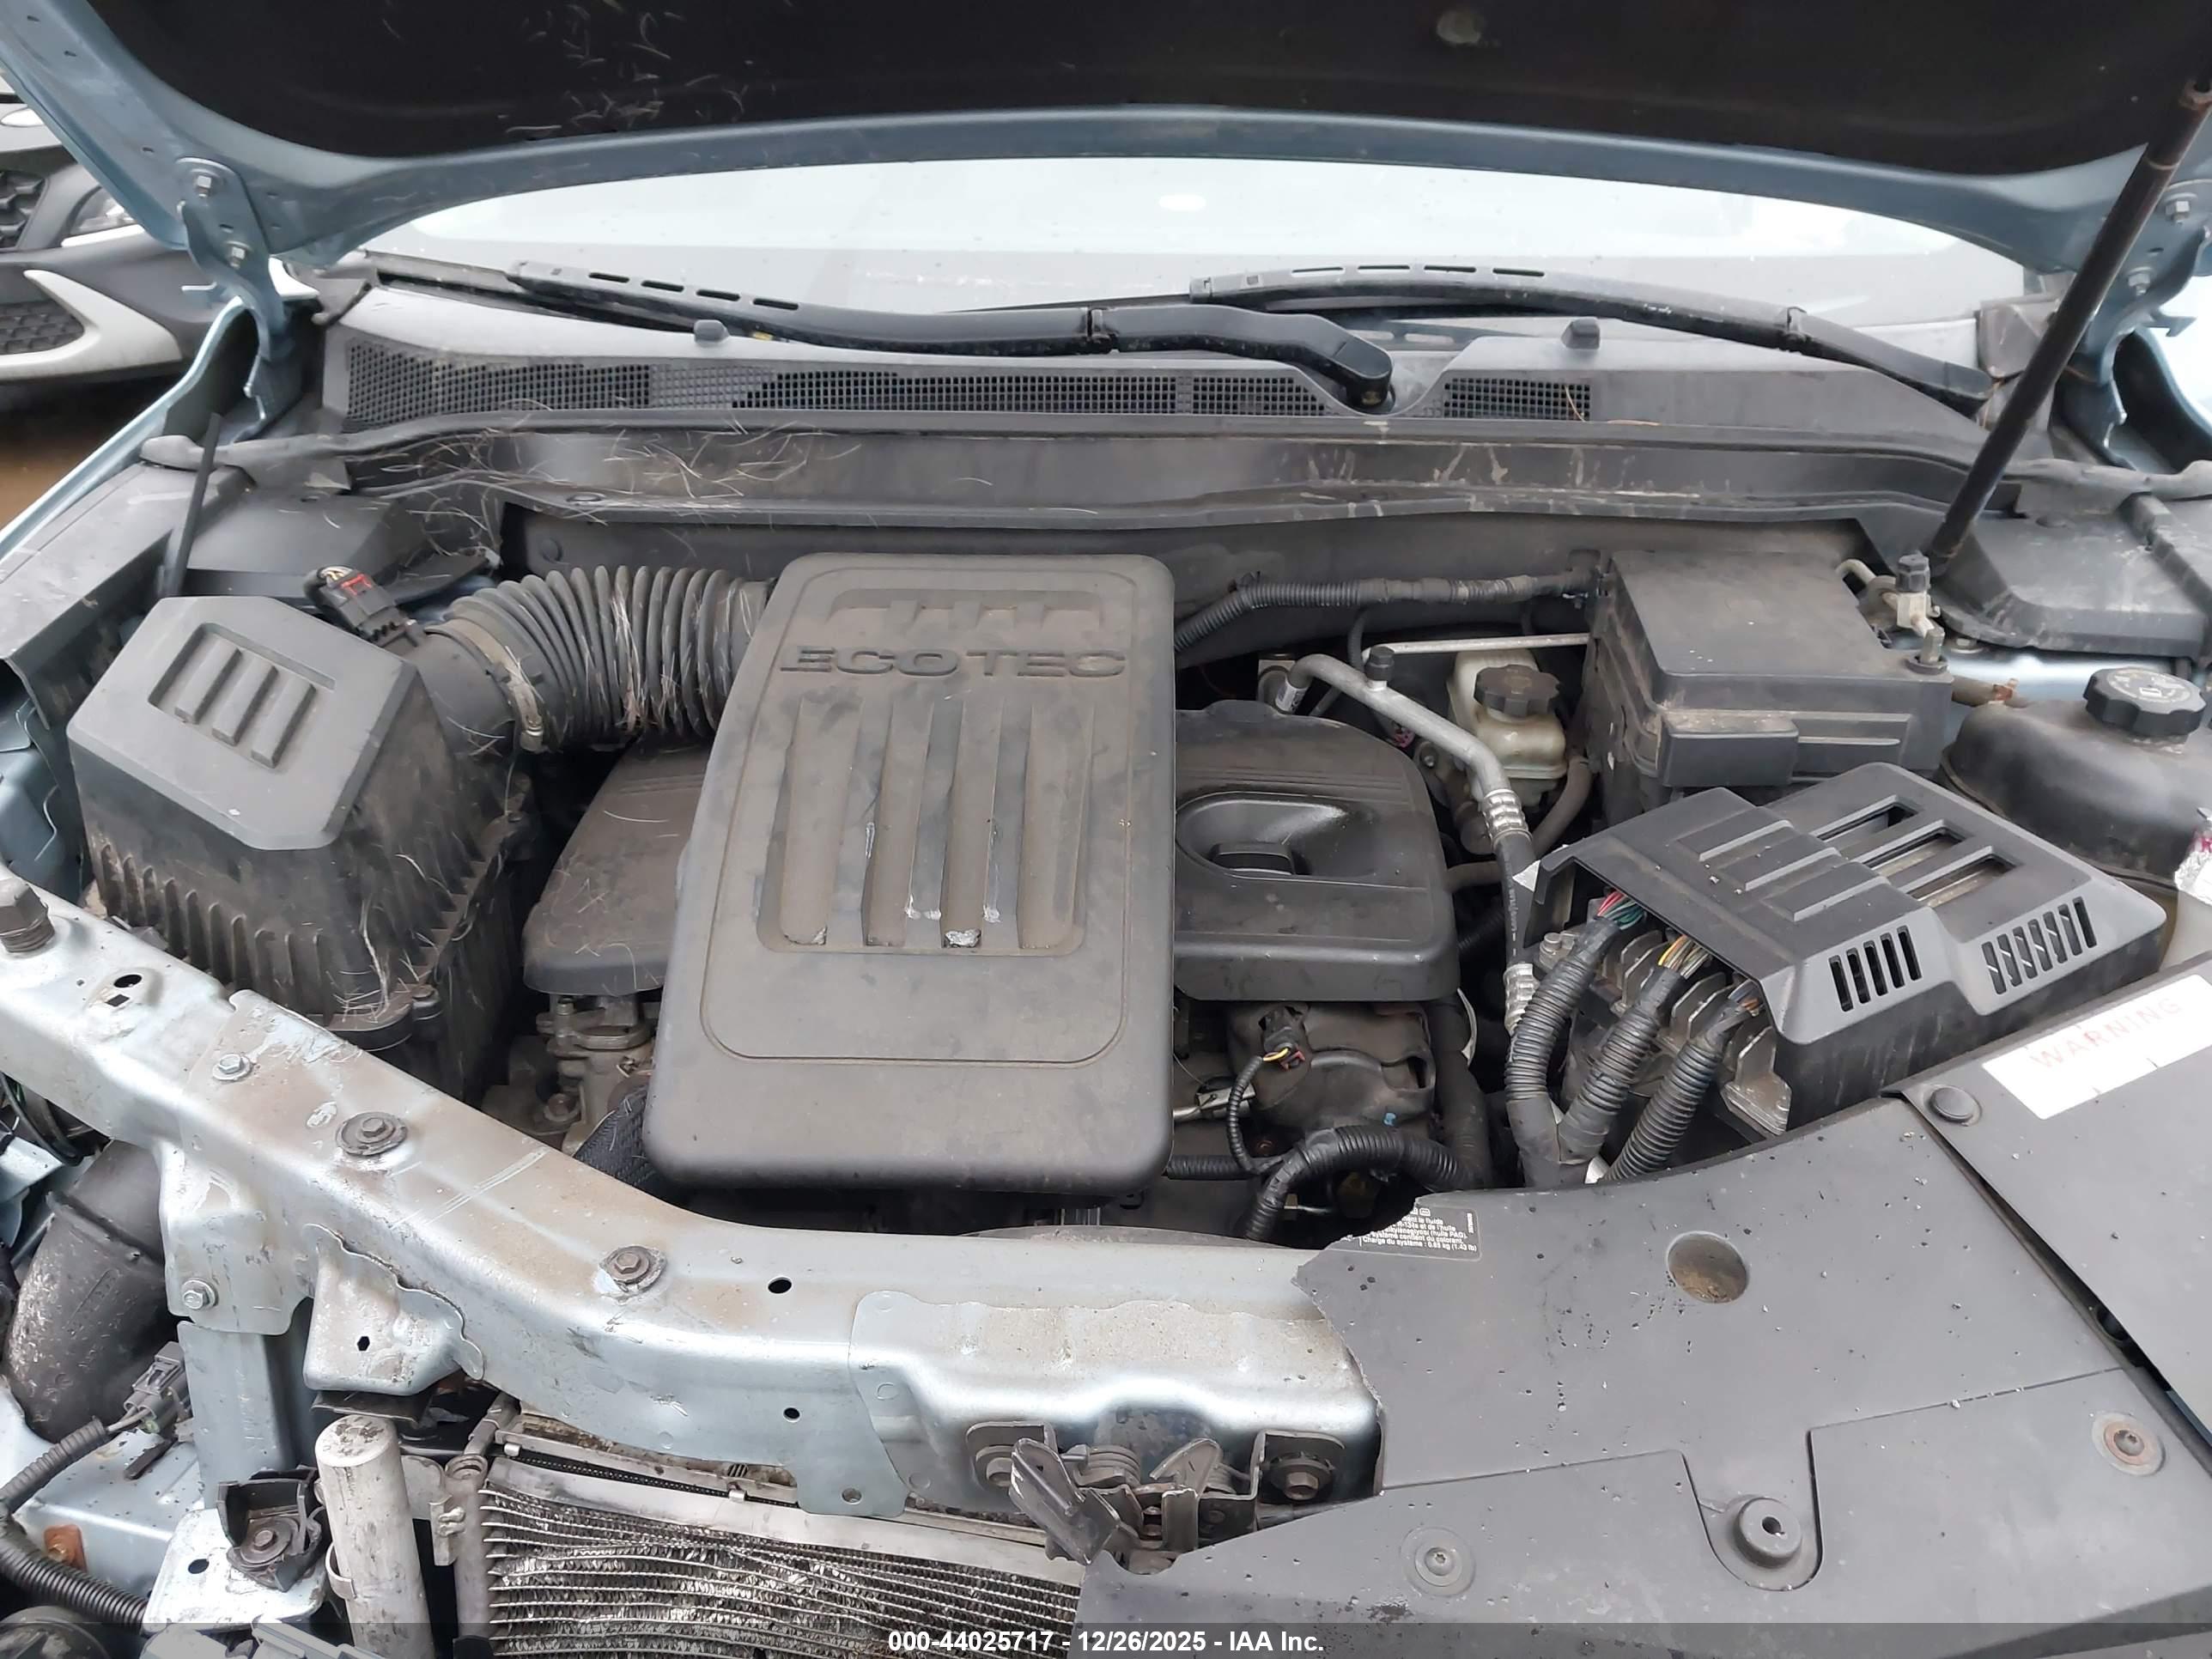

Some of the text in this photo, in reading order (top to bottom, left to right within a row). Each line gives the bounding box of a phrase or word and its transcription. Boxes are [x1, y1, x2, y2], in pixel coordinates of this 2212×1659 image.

[780, 645, 1127, 678] ECOTEC
[2029, 997, 2182, 1068] WARNING
[1362, 1237, 1386, 1245] Charge
[1386, 1237, 1395, 1246] du
